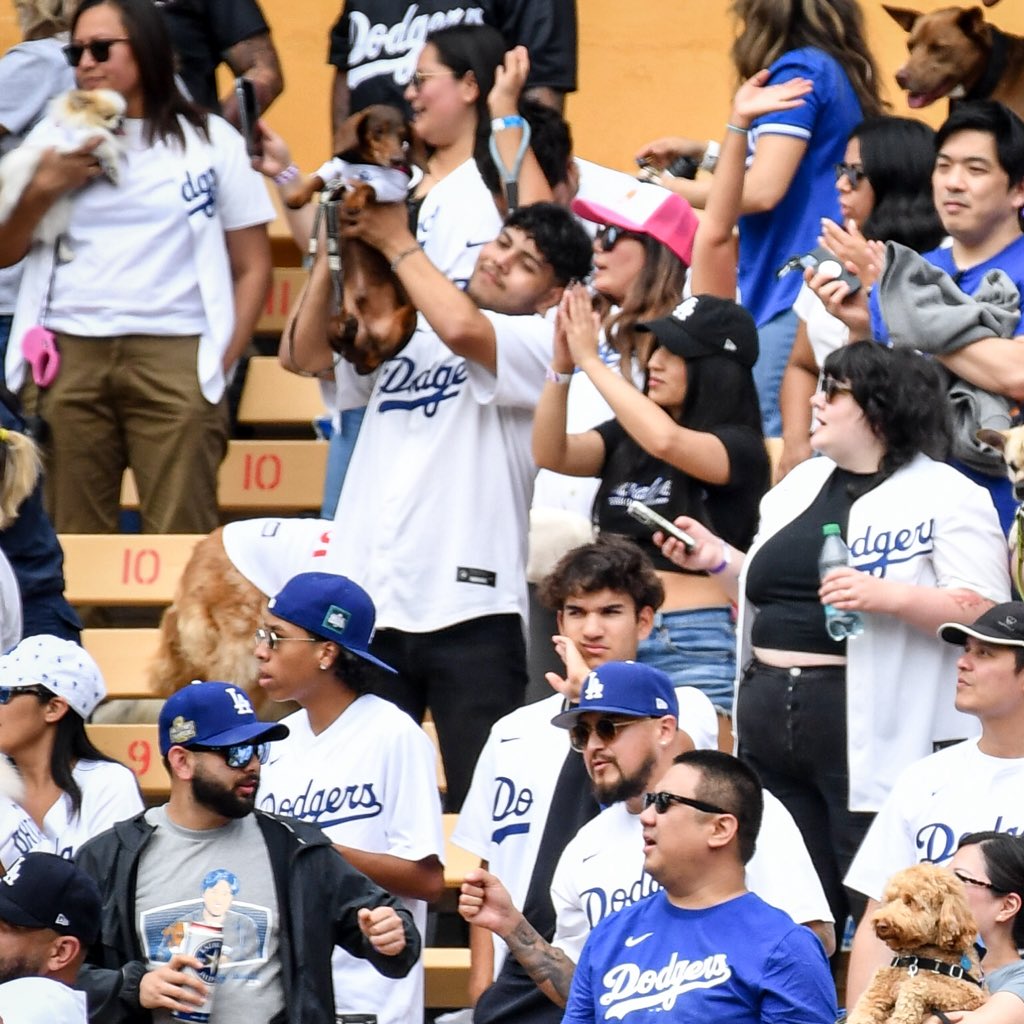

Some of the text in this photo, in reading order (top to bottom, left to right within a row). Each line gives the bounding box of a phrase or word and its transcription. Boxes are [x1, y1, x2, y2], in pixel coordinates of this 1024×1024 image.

[242, 453, 282, 491] 10
[122, 548, 161, 586] 10
[224, 687, 255, 715] LA
[128, 740, 151, 777] 9
[492, 776, 533, 844] Do
[600, 952, 732, 1020] Dodgers
